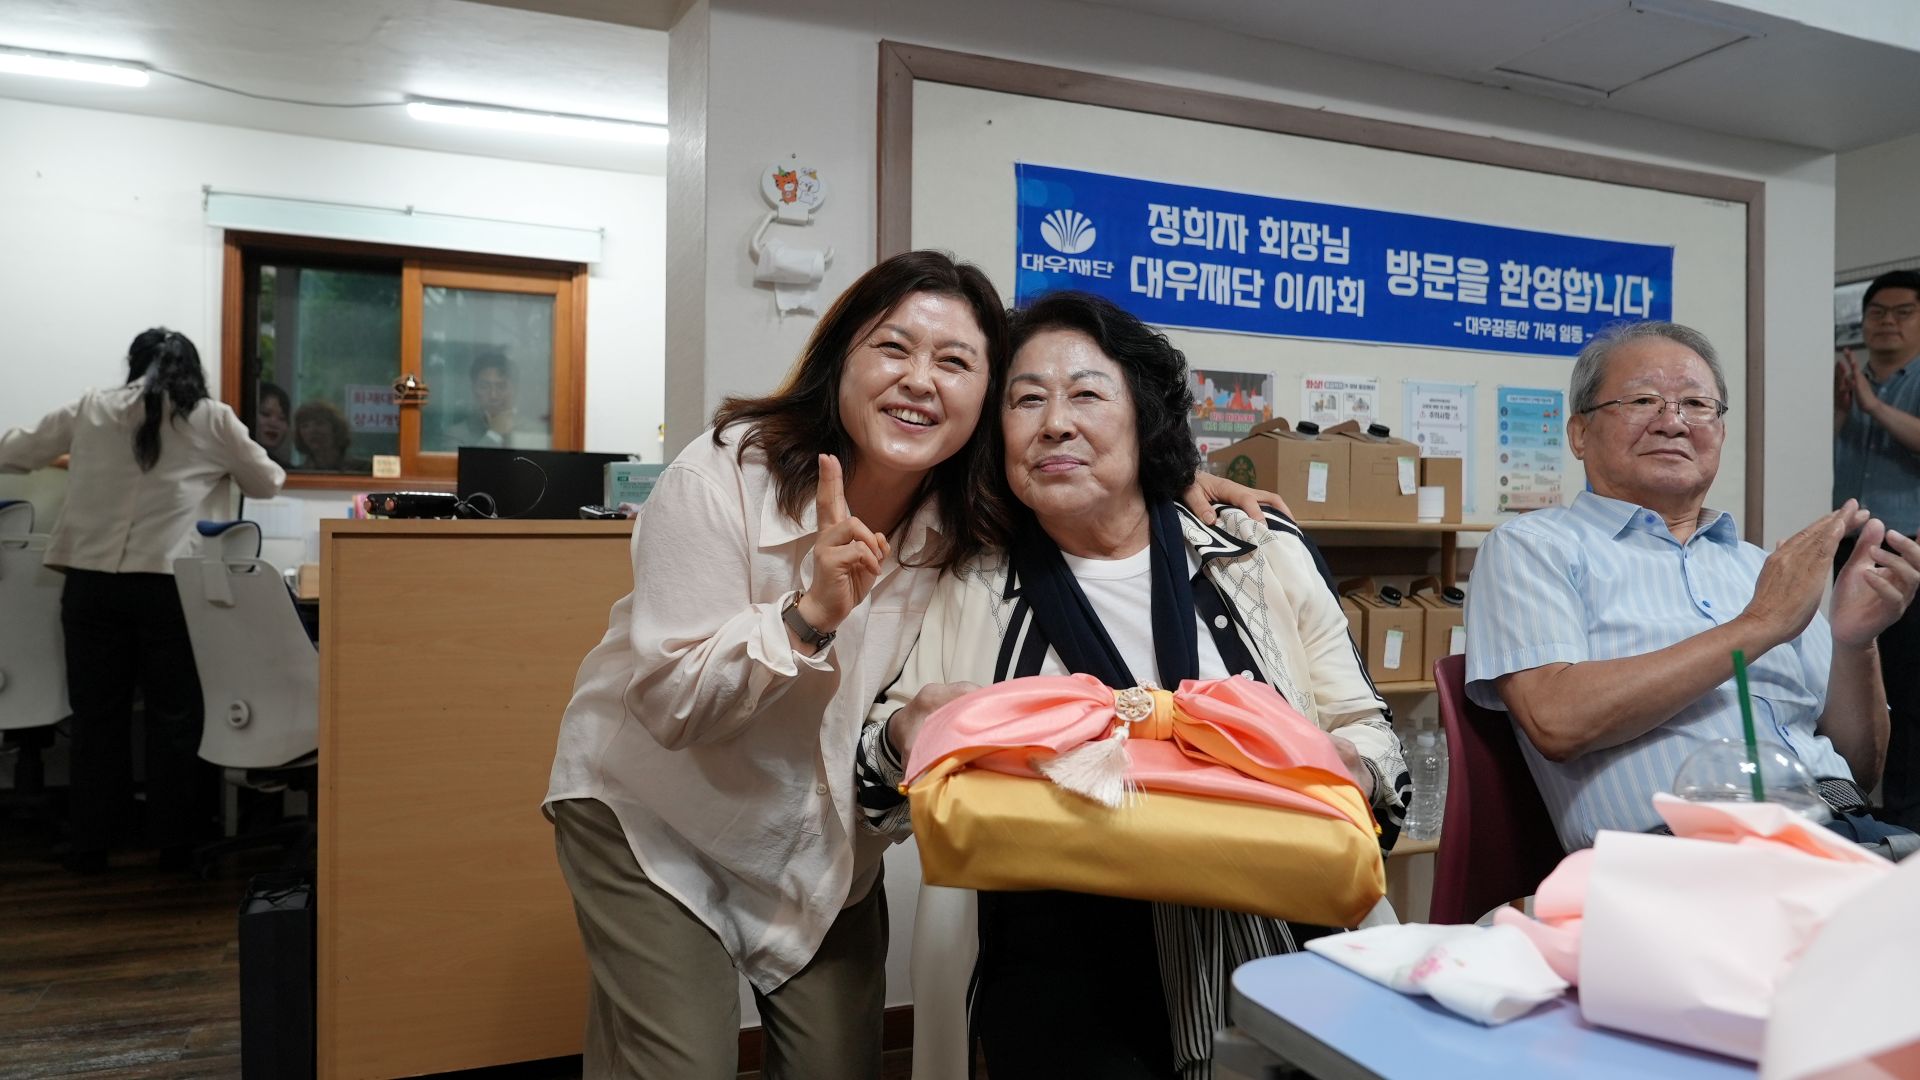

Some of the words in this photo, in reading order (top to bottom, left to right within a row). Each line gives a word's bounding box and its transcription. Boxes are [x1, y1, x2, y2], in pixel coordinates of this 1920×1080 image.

[1147, 203, 1249, 254] 정희자
[1258, 216, 1350, 265] 회장님
[1021, 252, 1115, 279] 대우재단
[1130, 255, 1265, 309] 대우재단
[1274, 271, 1365, 318] 이사회
[1386, 248, 1490, 305] 방문을
[1499, 260, 1654, 318] 환영합니다
[1465, 316, 1530, 340] 대우꿈동산
[1533, 322, 1556, 342] 가족
[1559, 324, 1583, 344] 일동
[354, 391, 393, 404] 화재대
